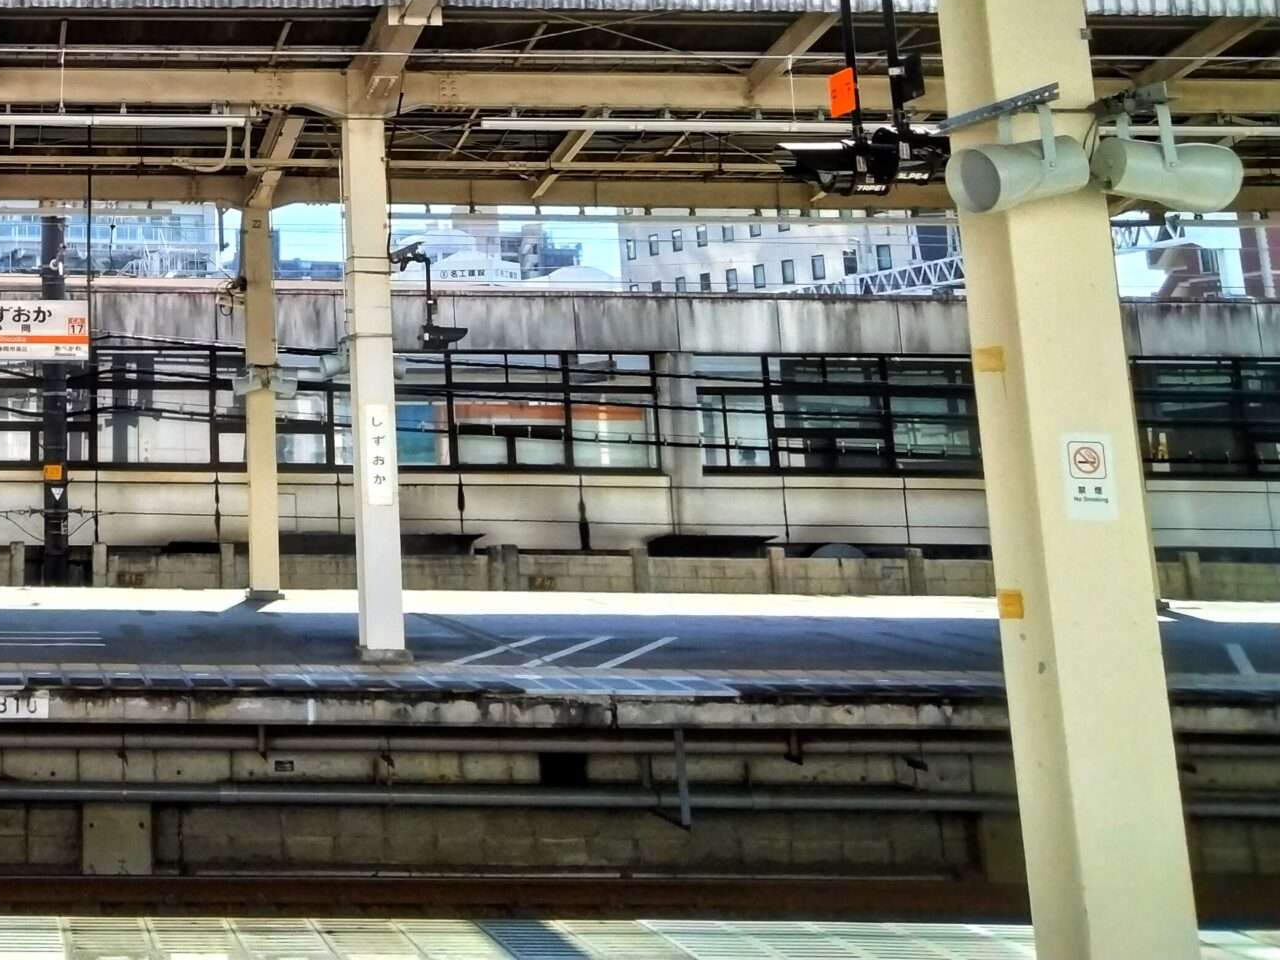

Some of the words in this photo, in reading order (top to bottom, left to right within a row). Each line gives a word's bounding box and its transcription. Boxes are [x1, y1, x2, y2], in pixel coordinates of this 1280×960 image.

[70, 324, 84, 334] 17
[371, 416, 387, 485] しずおか
